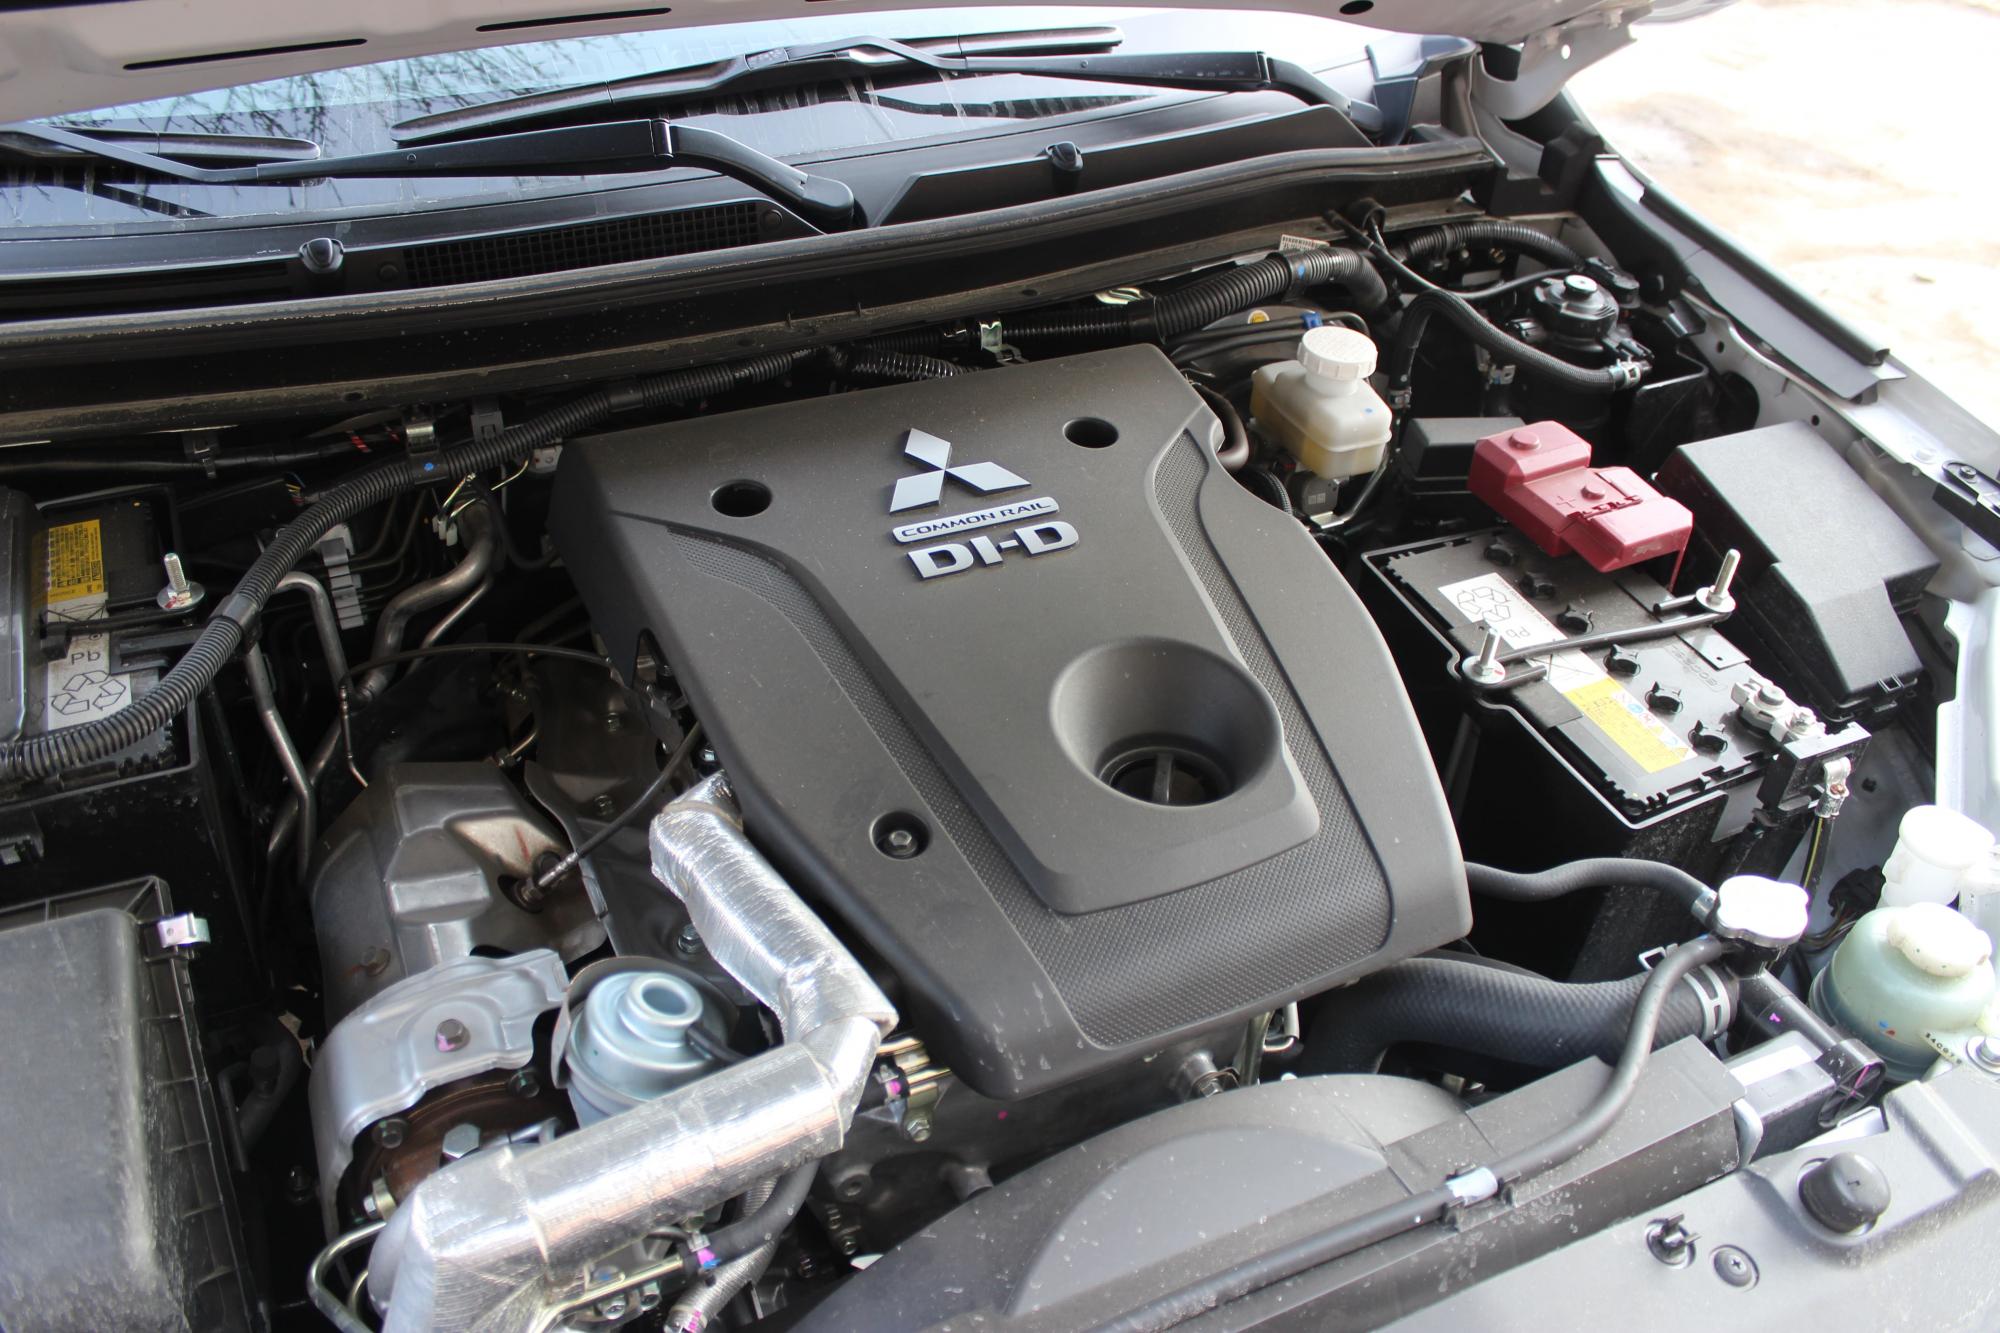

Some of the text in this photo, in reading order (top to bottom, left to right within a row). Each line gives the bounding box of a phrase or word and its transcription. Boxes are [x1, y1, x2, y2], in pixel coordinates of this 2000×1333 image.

[900, 500, 1052, 538] COMMON RAIL
[907, 520, 1080, 579] DI-D
[71, 650, 101, 666] Pb
